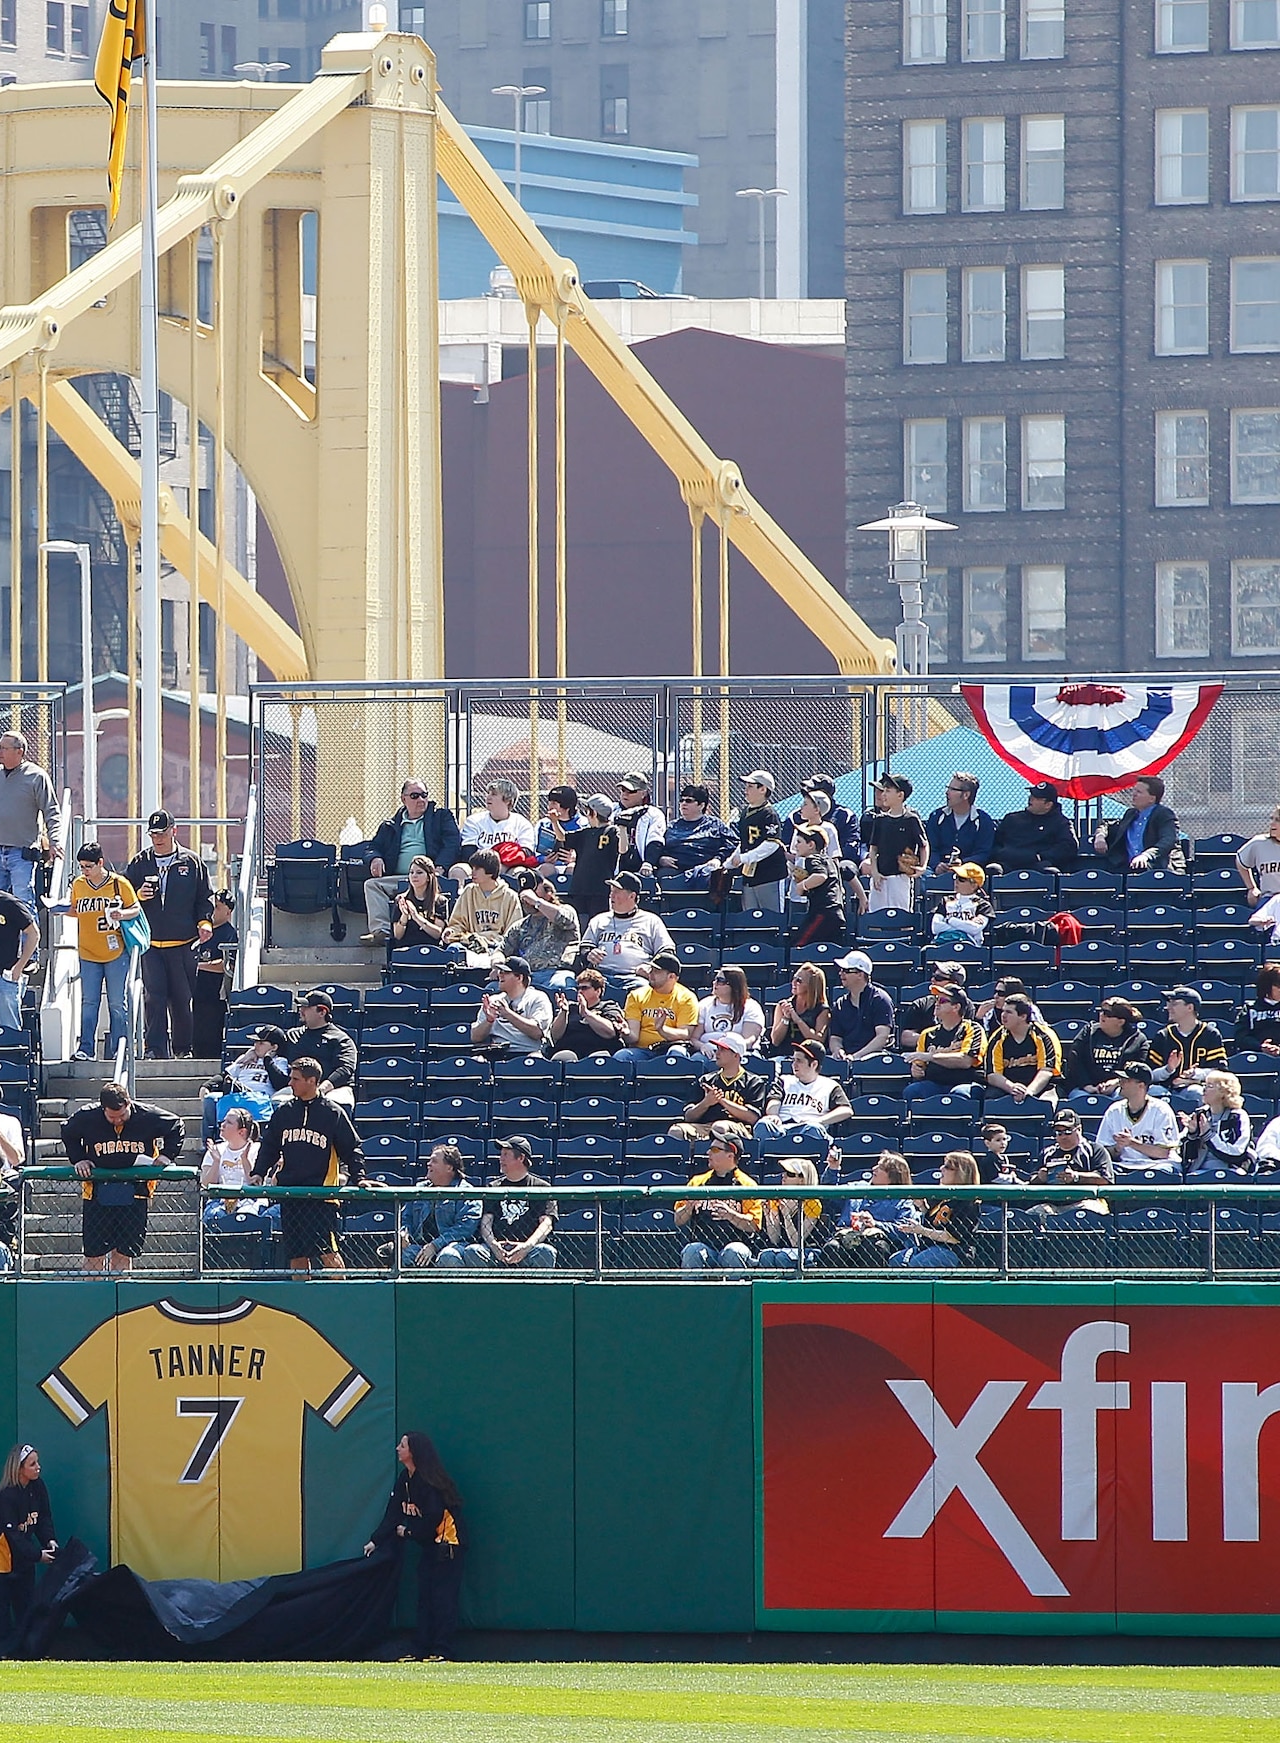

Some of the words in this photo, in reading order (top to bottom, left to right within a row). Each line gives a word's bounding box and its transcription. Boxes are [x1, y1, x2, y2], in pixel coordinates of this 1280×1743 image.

[153, 815, 160, 824] P
[598, 834, 610, 849] P
[748, 825, 760, 844] P
[520, 877, 526, 887] P
[475, 910, 499, 925] PITT
[1197, 1047, 1207, 1062] P
[282, 1128, 328, 1149] PIRATES
[94, 1140, 146, 1157] PIRATES
[149, 1344, 266, 1381] TANNER
[176, 1396, 246, 1484] 7
